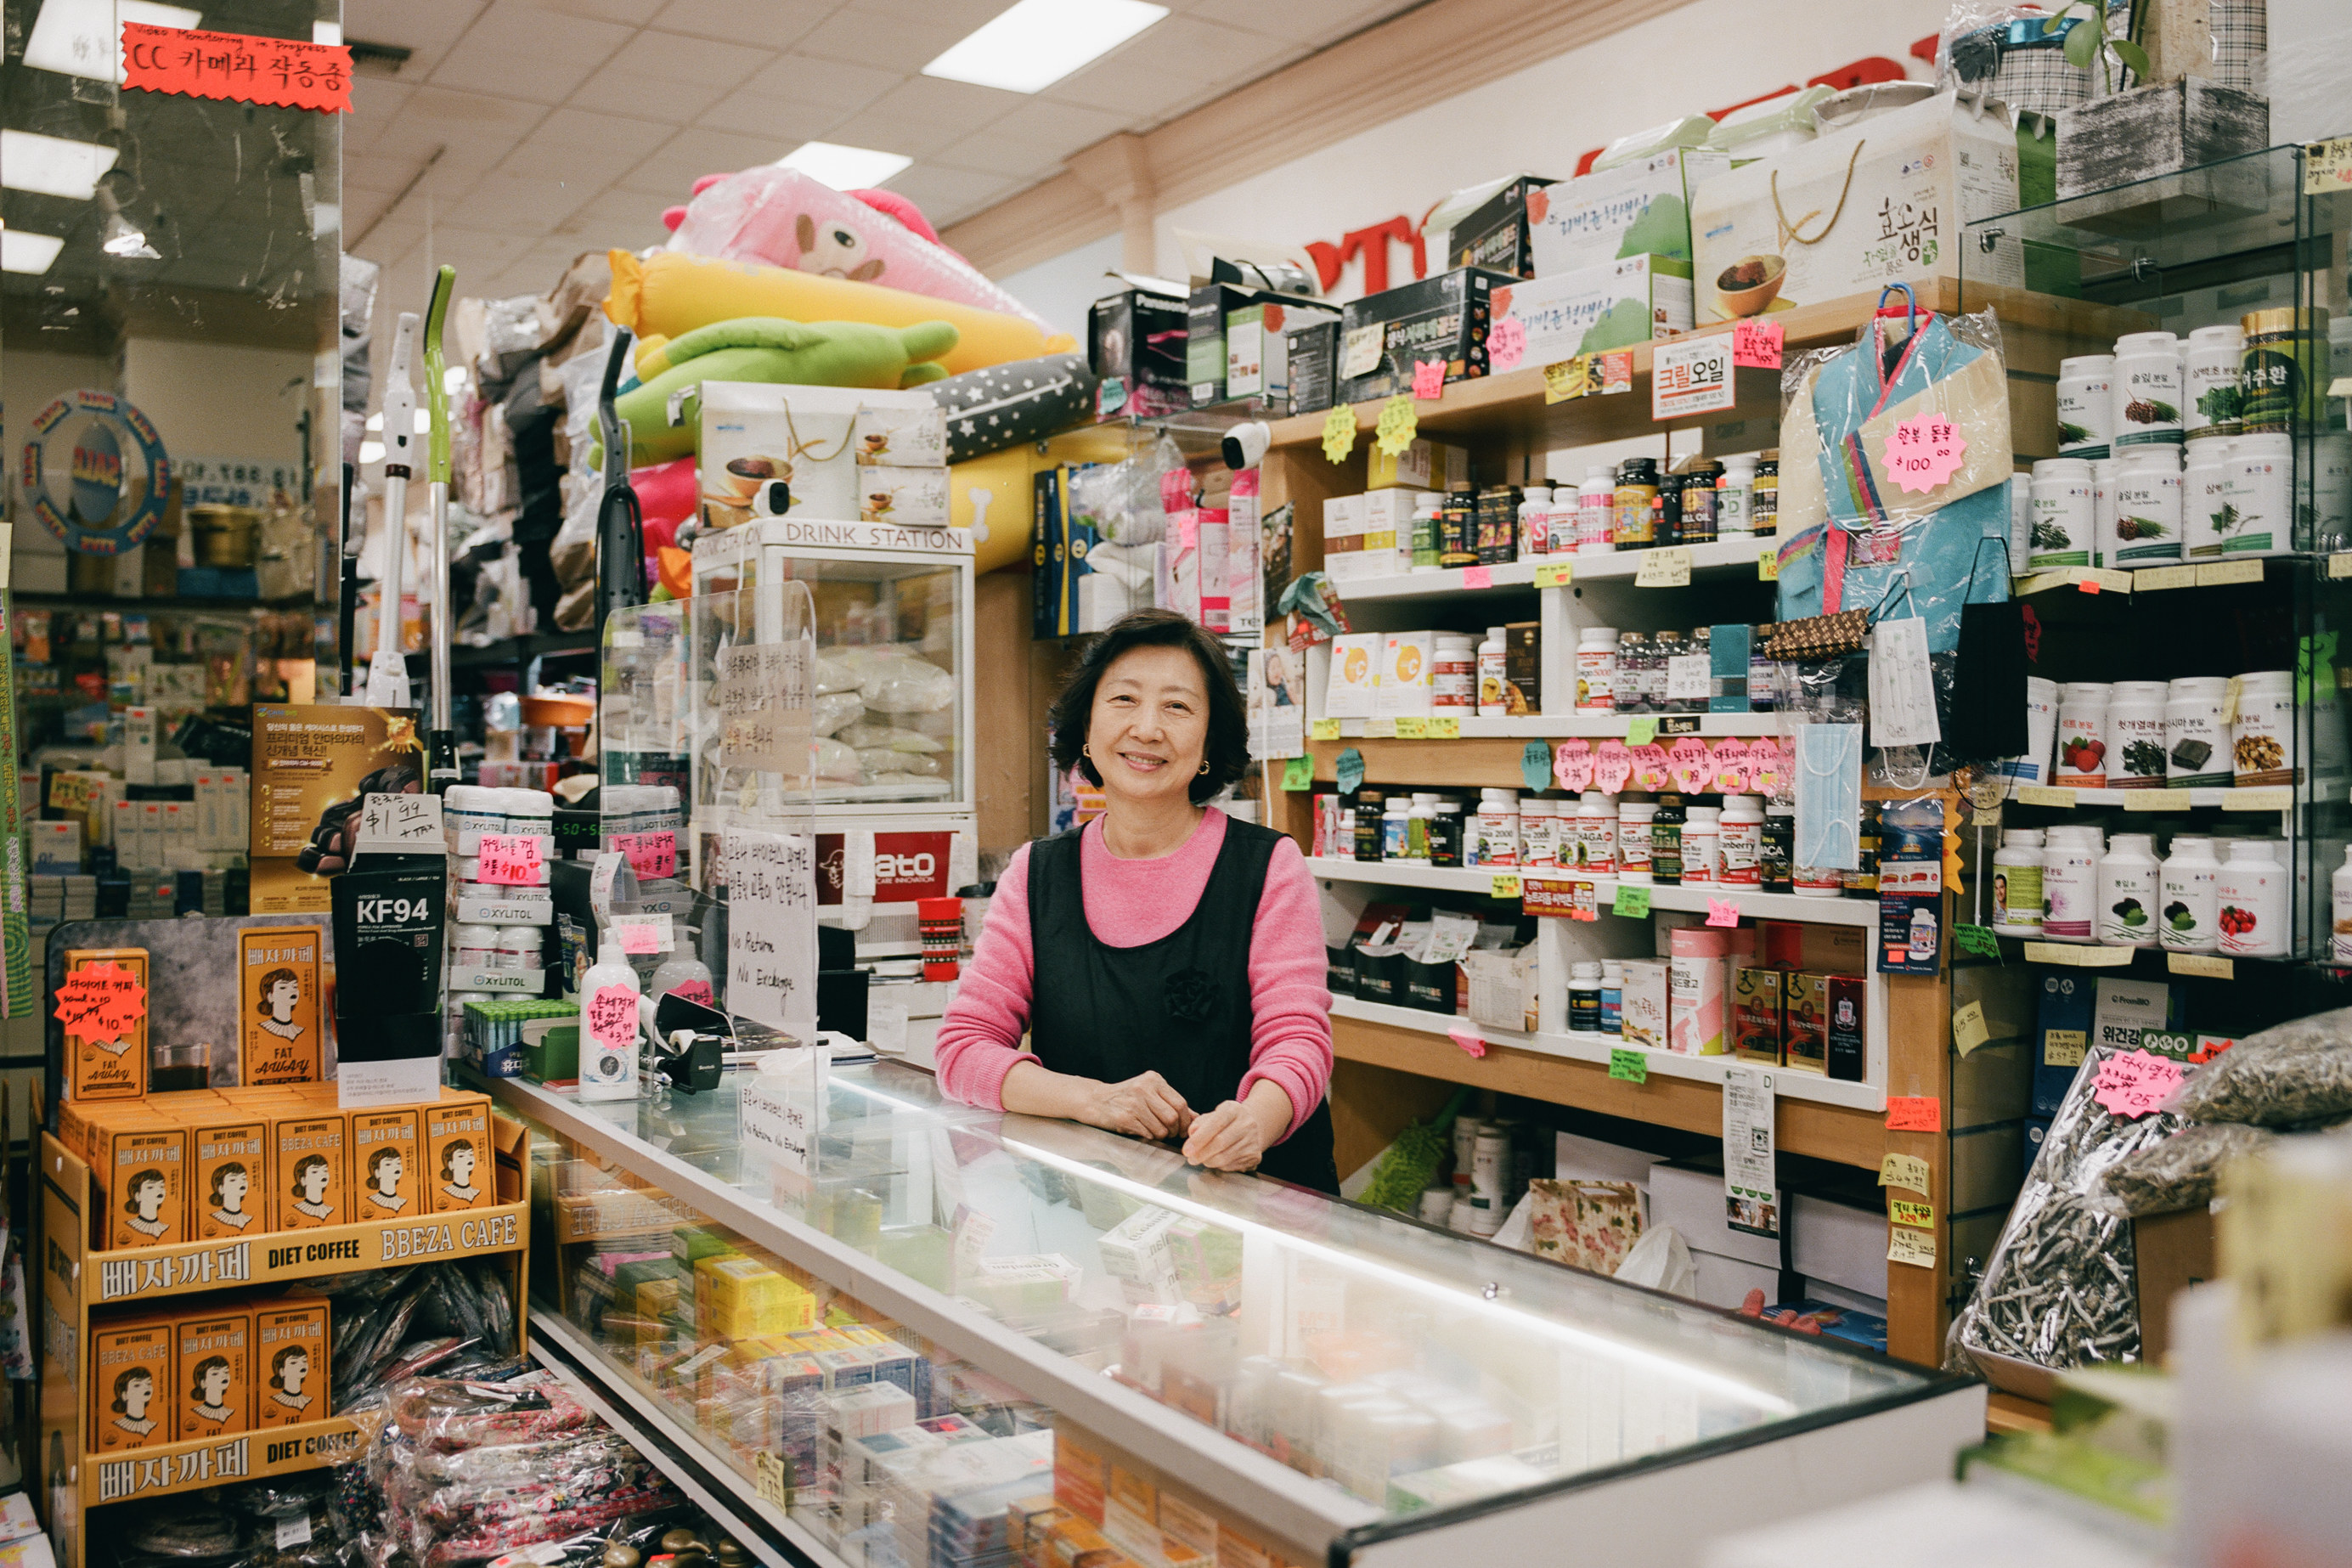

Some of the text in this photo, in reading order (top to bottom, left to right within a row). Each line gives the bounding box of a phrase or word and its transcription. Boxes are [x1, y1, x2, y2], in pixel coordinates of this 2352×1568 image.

[275, 40, 327, 56] Progress
[133, 43, 346, 91] CC 카메라 작동중
[1877, 196, 1915, 241] 효소
[1899, 206, 1937, 261] 생식
[1658, 357, 1723, 389] 크릴오일
[2132, 372, 2168, 384] 솔잎 분말
[1898, 426, 1921, 445] 한복
[2134, 491, 2149, 500] 분말
[1728, 500, 1740, 513] D
[1698, 512, 1711, 522] OIL
[787, 522, 962, 550] DRINK STATION
[1356, 660, 1367, 677] C
[1408, 657, 1419, 674] C
[2189, 719, 2204, 728] 분말
[2245, 713, 2261, 724] 분말
[267, 733, 365, 746] 프리미엄 안마의자의
[266, 745, 327, 758] 신개념 혁신!
[1673, 747, 1706, 764] 모링가
[371, 794, 403, 805] 한국산
[365, 802, 420, 835] $1 99
[413, 824, 436, 838] TAX
[472, 821, 503, 832] XYLITOL
[520, 826, 551, 836] XYLITOL
[482, 838, 534, 859] 자일리톨 껌
[728, 834, 748, 860] 코로나
[752, 843, 786, 866] 바이러스
[894, 875, 935, 885] INNOVATION
[357, 898, 430, 924] KF94
[491, 910, 533, 919] XYLITOL
[731, 931, 776, 953] No Return
[247, 945, 314, 966] 빼자까페
[70, 978, 134, 992] 다이어트 커피
[485, 977, 526, 987] XYLITOL
[736, 964, 796, 1017] No Exchange
[99, 996, 111, 1004] 10
[596, 994, 635, 1011] 손세정제
[2102, 1025, 2141, 1046] 위건강
[274, 1047, 293, 1059] FAT
[103, 1061, 117, 1069] FAT
[256, 1060, 310, 1074] AWAY
[2122, 1055, 2146, 1073] 다시
[87, 1069, 130, 1080] AWAY
[1764, 1075, 1772, 1088] D
[369, 1116, 402, 1126] DIET COFFEE
[442, 1108, 473, 1120] DIET COFFEE
[294, 1123, 328, 1133] DIET COFFEE
[431, 1115, 486, 1138] 빼자까페
[753, 1124, 773, 1143] Return
[132, 1137, 167, 1147] DIET COFFEE
[214, 1130, 248, 1141] DIET COFFEE
[358, 1124, 415, 1146] 빼자까페
[200, 1137, 262, 1161] 빼자까페
[280, 1133, 341, 1153] BBEZA CAFE
[117, 1145, 181, 1167] 빼자까페
[101, 1213, 519, 1300] 빼자까페 DIET COFFEE BBEZA CAFE
[274, 1313, 310, 1324] DIET COFFEE
[195, 1323, 231, 1334] DIET COFFEE
[262, 1320, 323, 1343] 빼자까페
[116, 1334, 153, 1345] DIET COFFEE
[183, 1330, 245, 1354] 빼자까페
[100, 1343, 167, 1367] BBEZA CAFE
[285, 1415, 301, 1425] FAT
[206, 1428, 223, 1437] FAT
[99, 1430, 359, 1503] 빼자까페 DIET COFFEE
